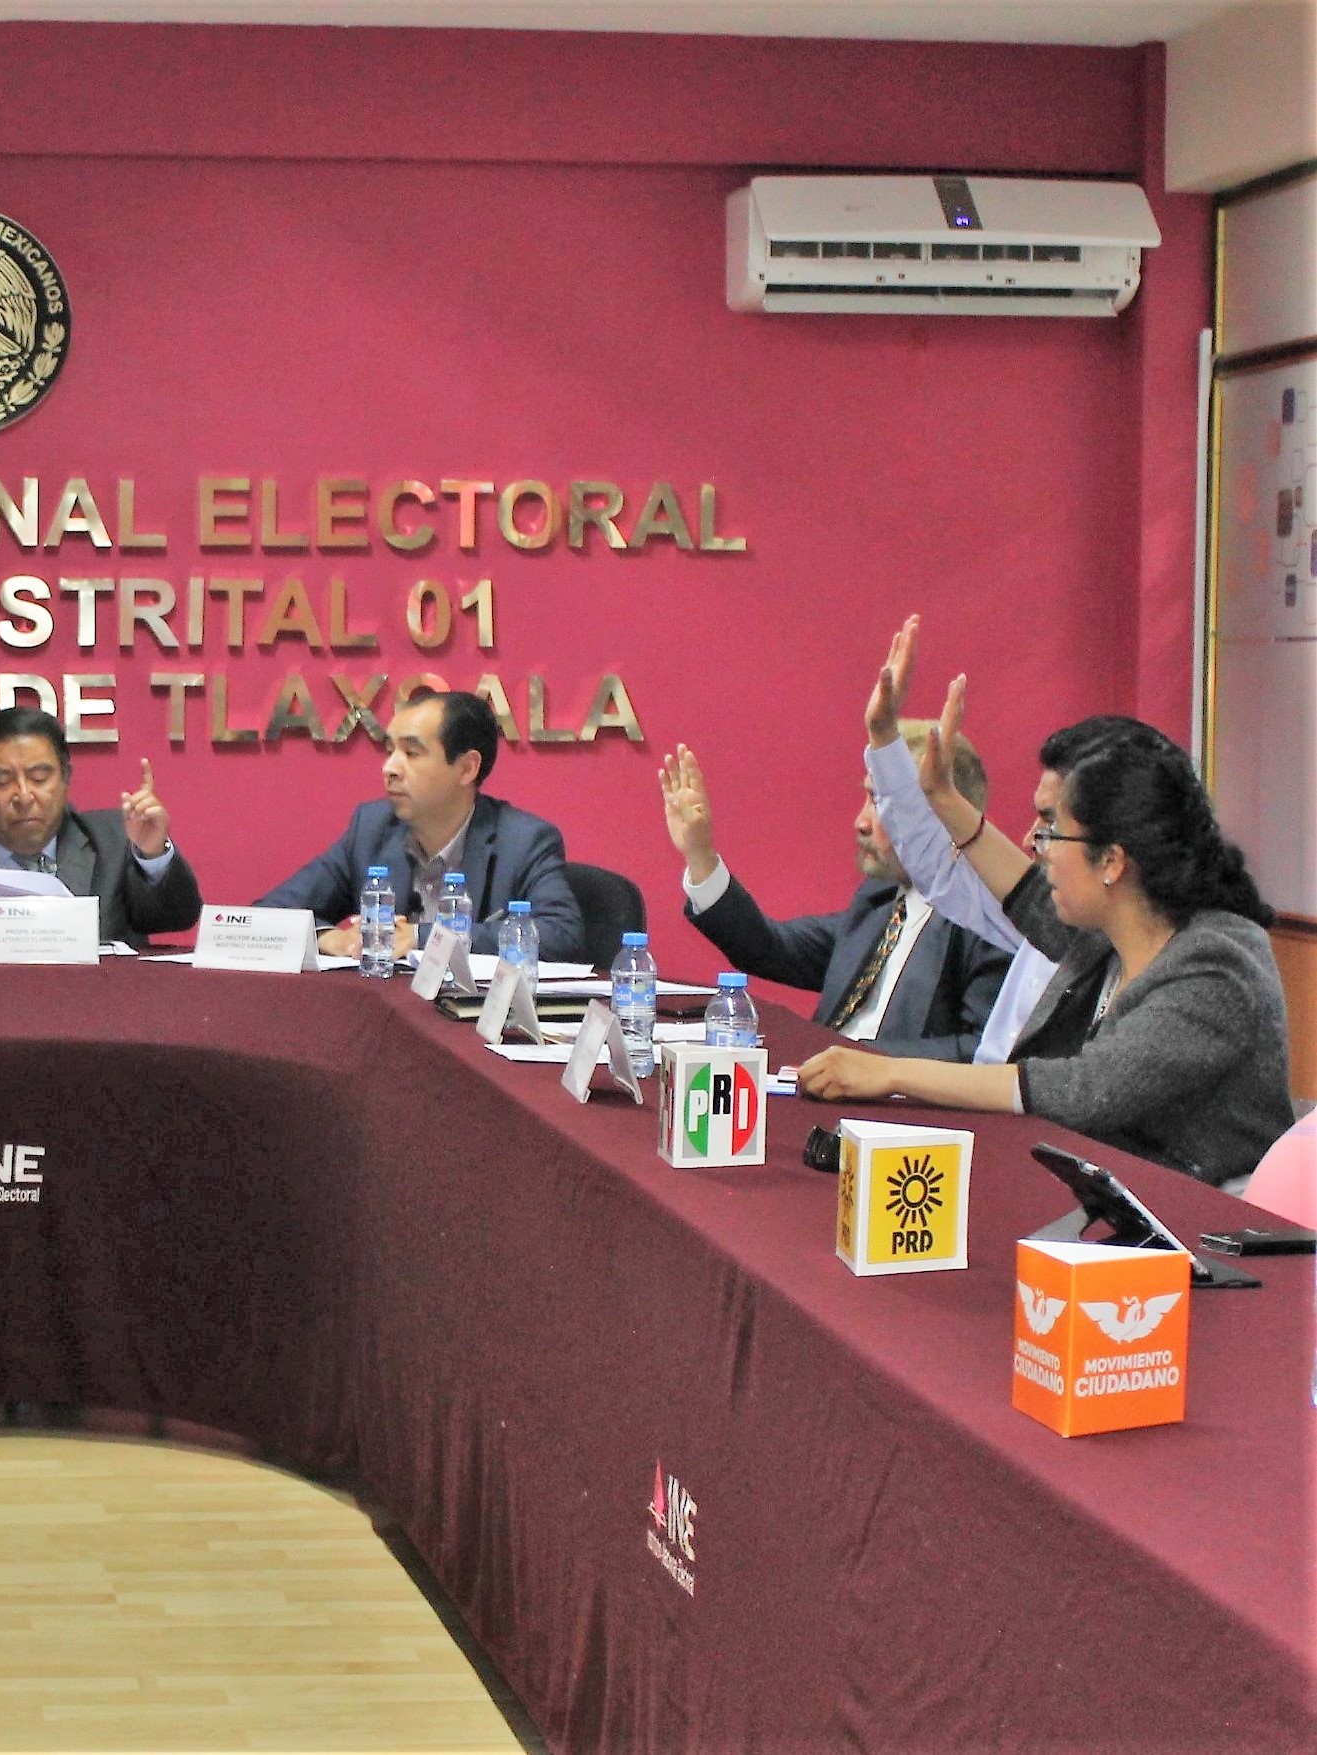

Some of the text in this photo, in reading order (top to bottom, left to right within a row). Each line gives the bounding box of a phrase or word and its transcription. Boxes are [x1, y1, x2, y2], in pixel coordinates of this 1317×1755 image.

[199, 478, 748, 552] ELECTORAL
[406, 578, 495, 648] 01
[226, 915, 253, 925] INE
[687, 1074, 749, 1133] PRI
[891, 1229, 934, 1255] PRD
[1017, 1337, 1061, 1372] MOVIMIENTO
[1085, 1350, 1173, 1375] MOVIMIENTO
[1014, 1354, 1065, 1397] CIUDADANO
[1074, 1366, 1181, 1398] CIUDADANO
